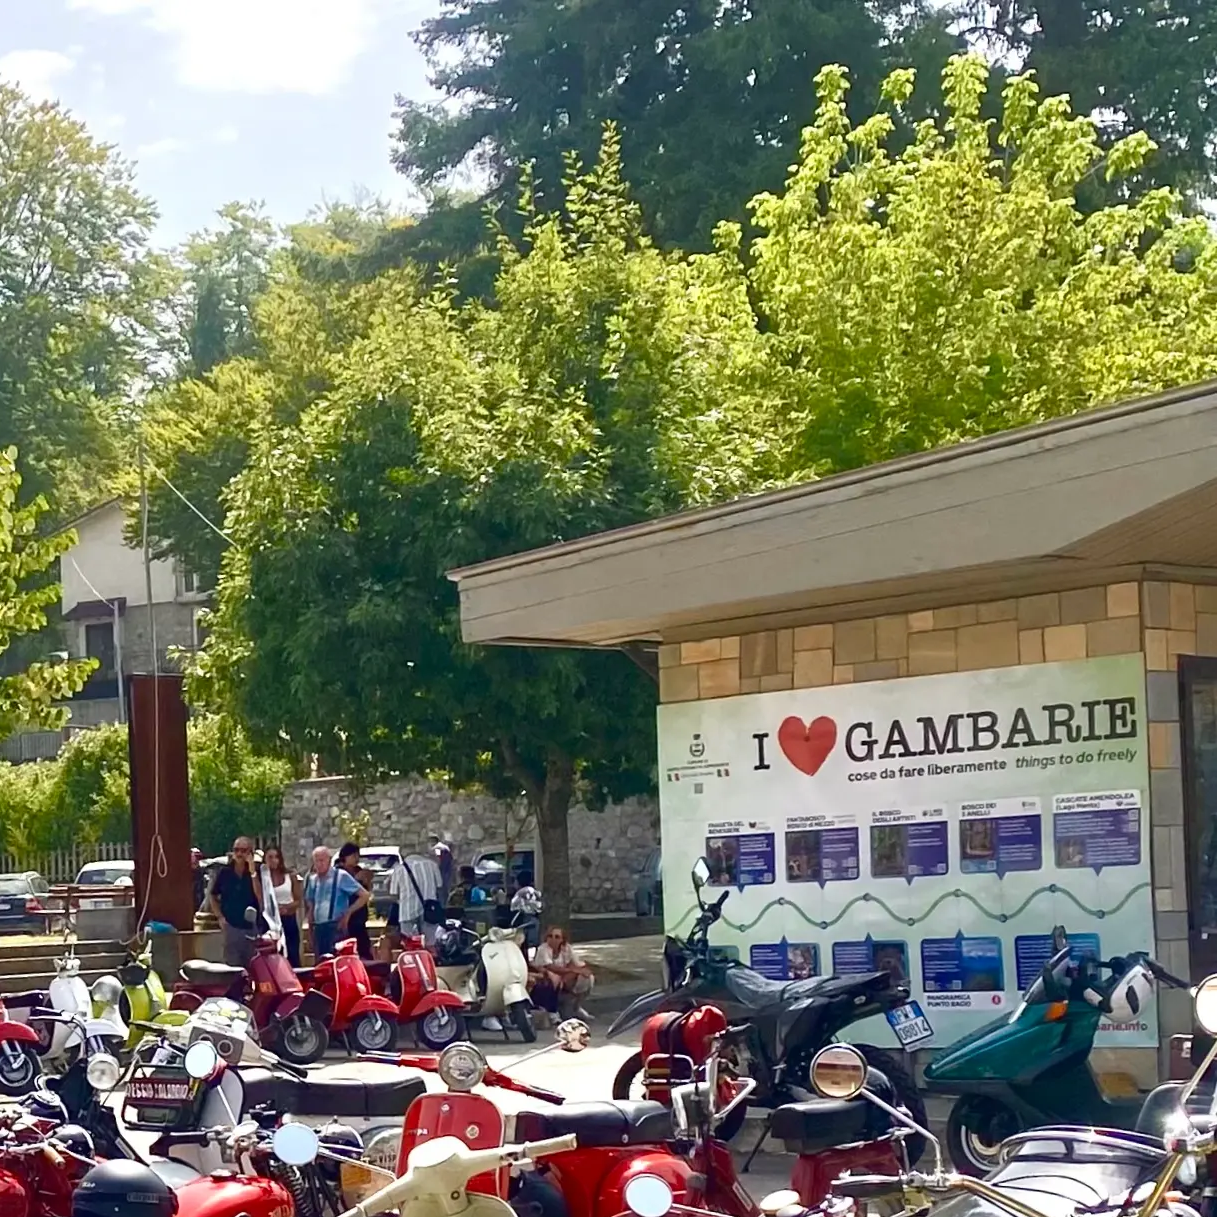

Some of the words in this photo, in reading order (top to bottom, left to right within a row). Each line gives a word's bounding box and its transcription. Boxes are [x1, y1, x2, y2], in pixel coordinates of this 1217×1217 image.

[752, 733, 771, 771] I
[844, 696, 1138, 763] GAMBARIE
[848, 770, 877, 782] cose
[880, 767, 896, 780] da
[898, 765, 925, 778] fare
[926, 758, 1007, 775] liberamente
[1015, 754, 1056, 770] things
[1058, 753, 1074, 766] to
[1076, 750, 1095, 764] do
[1096, 747, 1137, 762] freely
